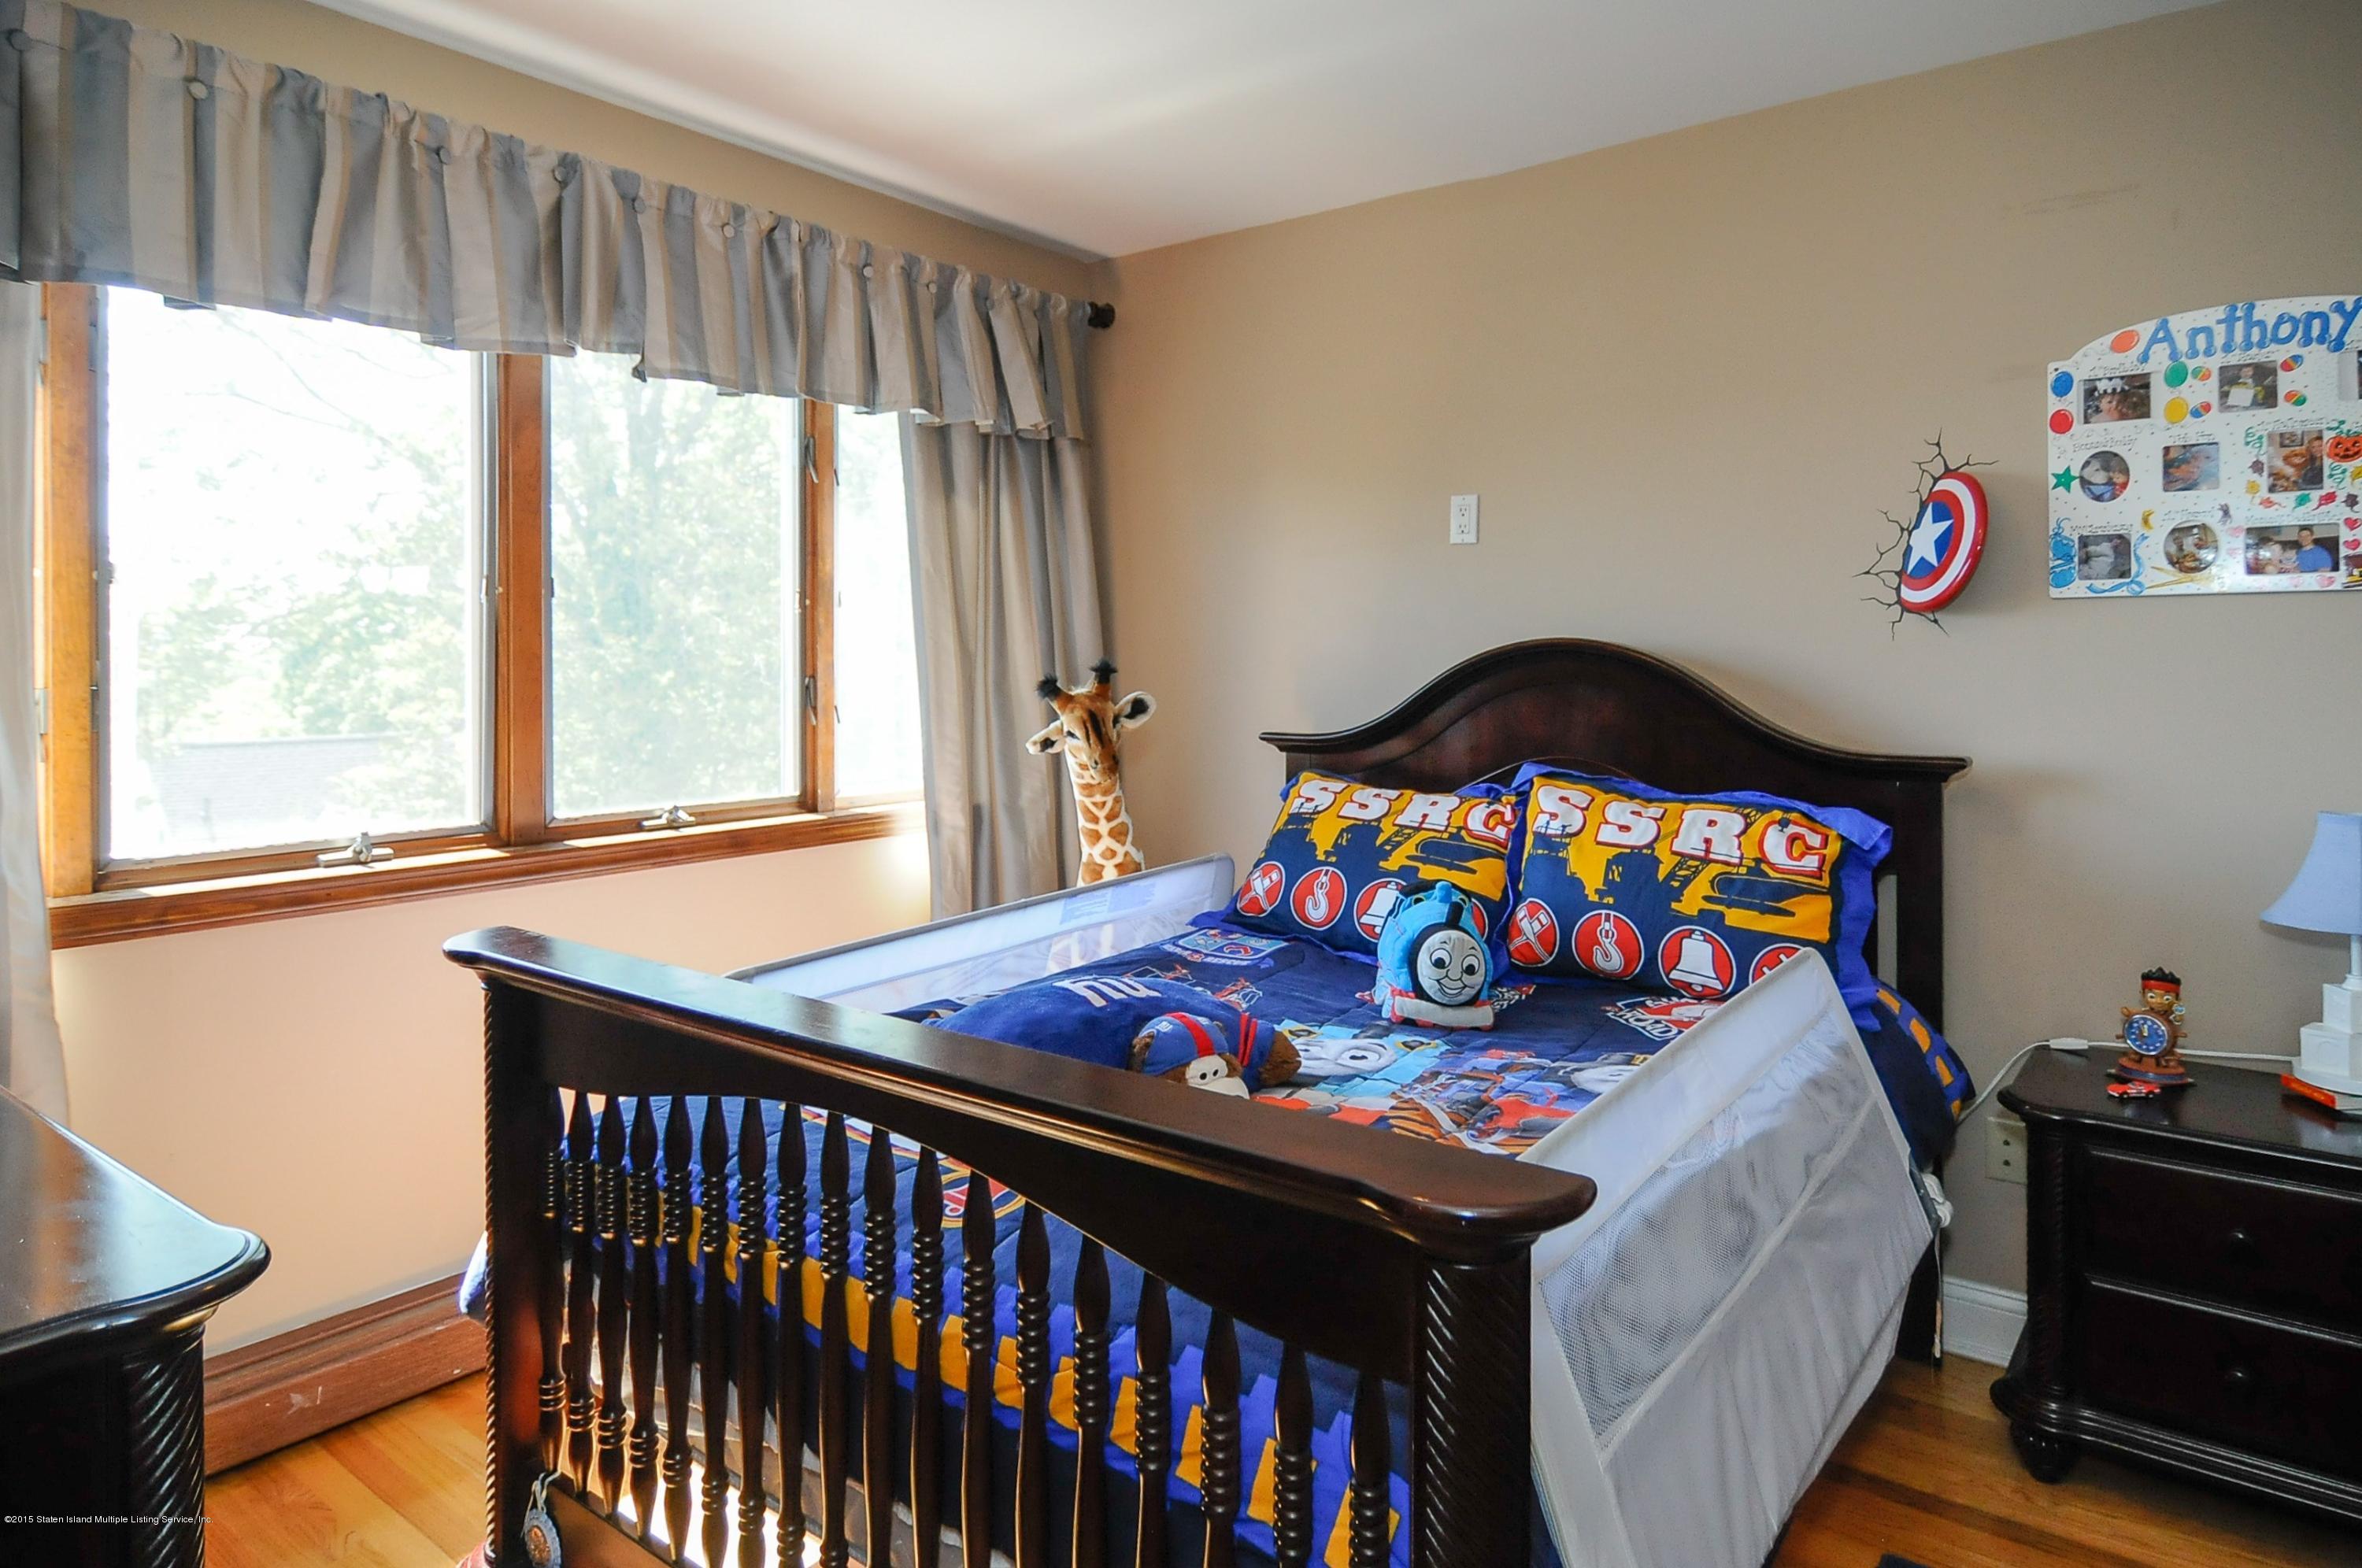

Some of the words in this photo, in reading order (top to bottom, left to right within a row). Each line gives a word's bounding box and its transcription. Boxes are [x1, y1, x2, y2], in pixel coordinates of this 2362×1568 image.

[2136, 296, 2362, 364] Anthony
[1287, 778, 1517, 850] SSRC
[1532, 784, 1828, 879] SSRC
